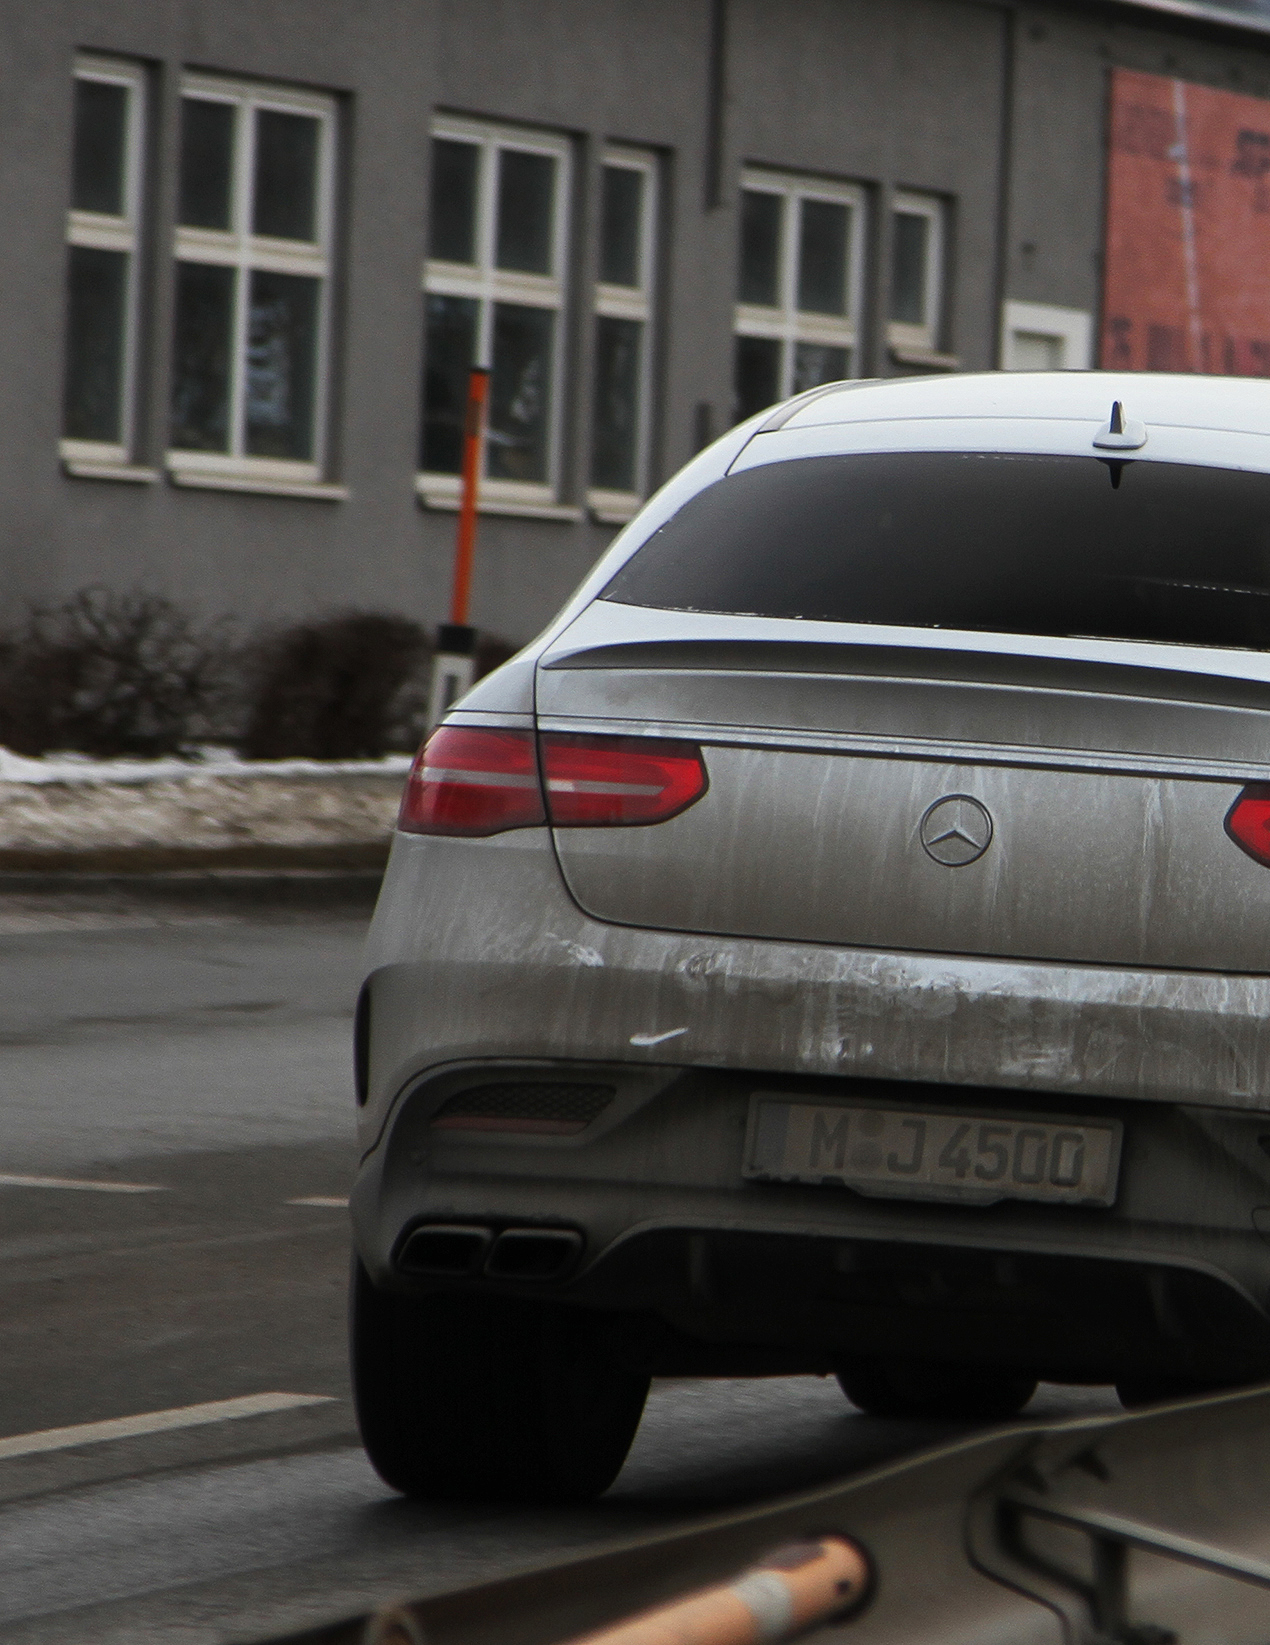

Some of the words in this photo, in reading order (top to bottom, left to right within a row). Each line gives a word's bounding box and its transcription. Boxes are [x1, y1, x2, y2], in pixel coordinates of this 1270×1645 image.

[809, 1111, 850, 1169] M
[887, 1118, 927, 1175] J
[938, 1123, 1086, 1188] 4500
